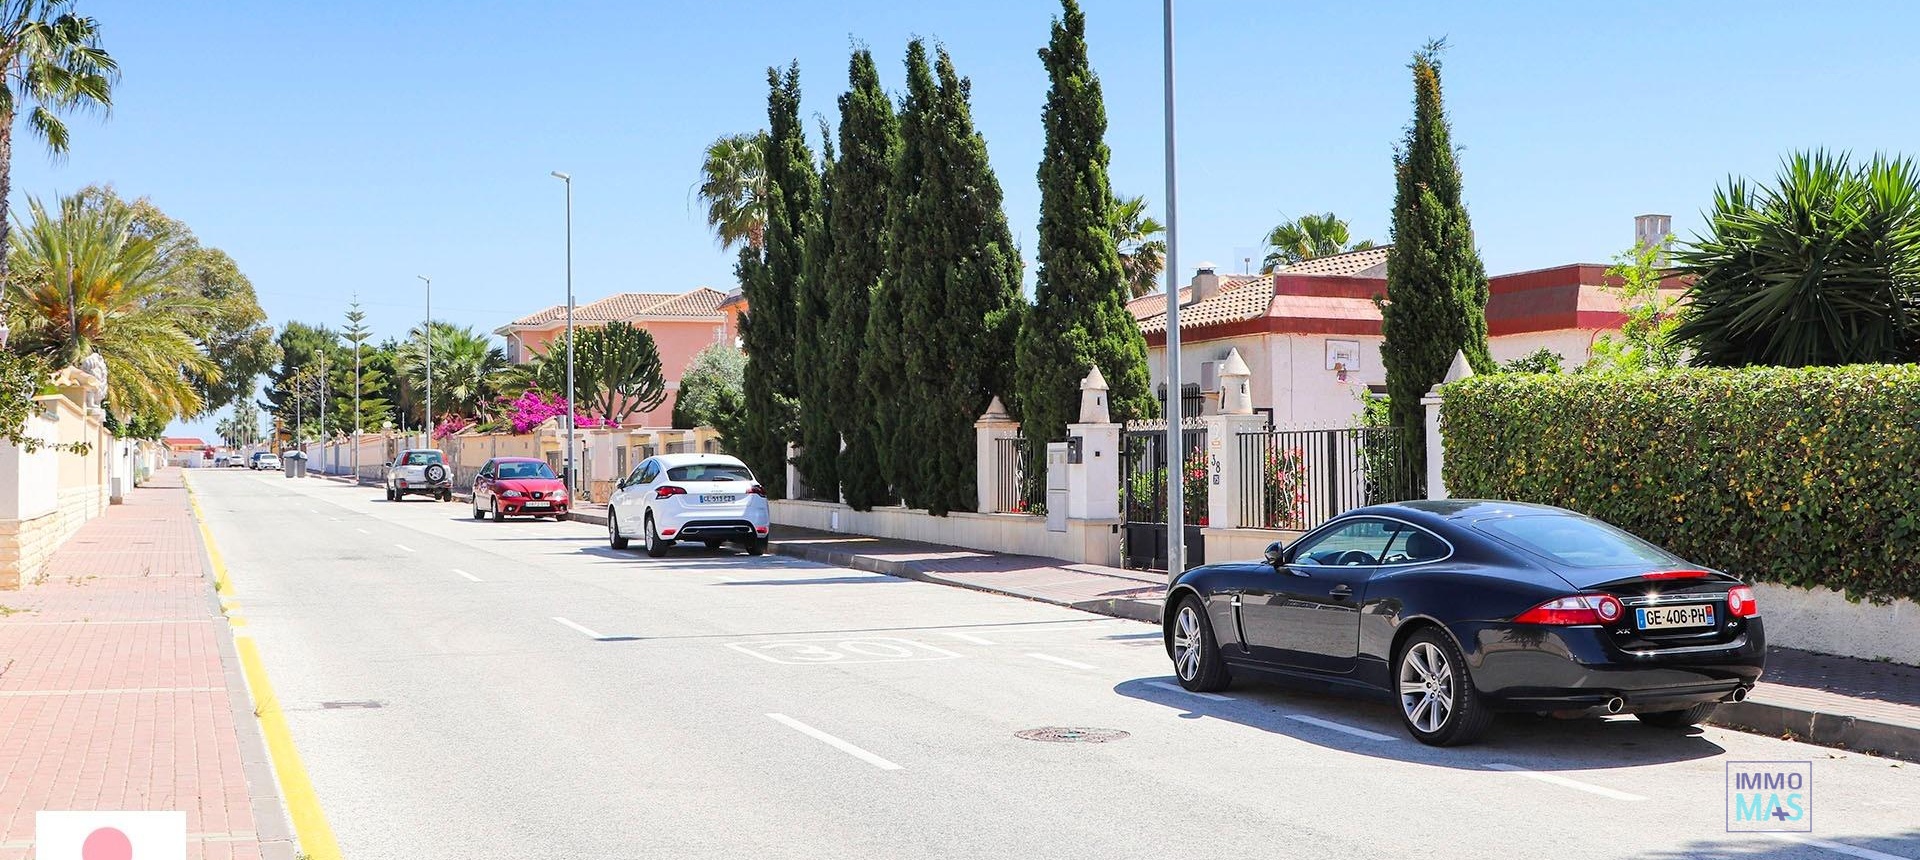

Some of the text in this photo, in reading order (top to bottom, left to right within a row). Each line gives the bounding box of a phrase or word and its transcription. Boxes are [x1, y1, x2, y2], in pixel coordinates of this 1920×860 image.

[1211, 454, 1221, 473] 38
[1646, 608, 1706, 625] GE-406-PH
[758, 641, 914, 661] 30
